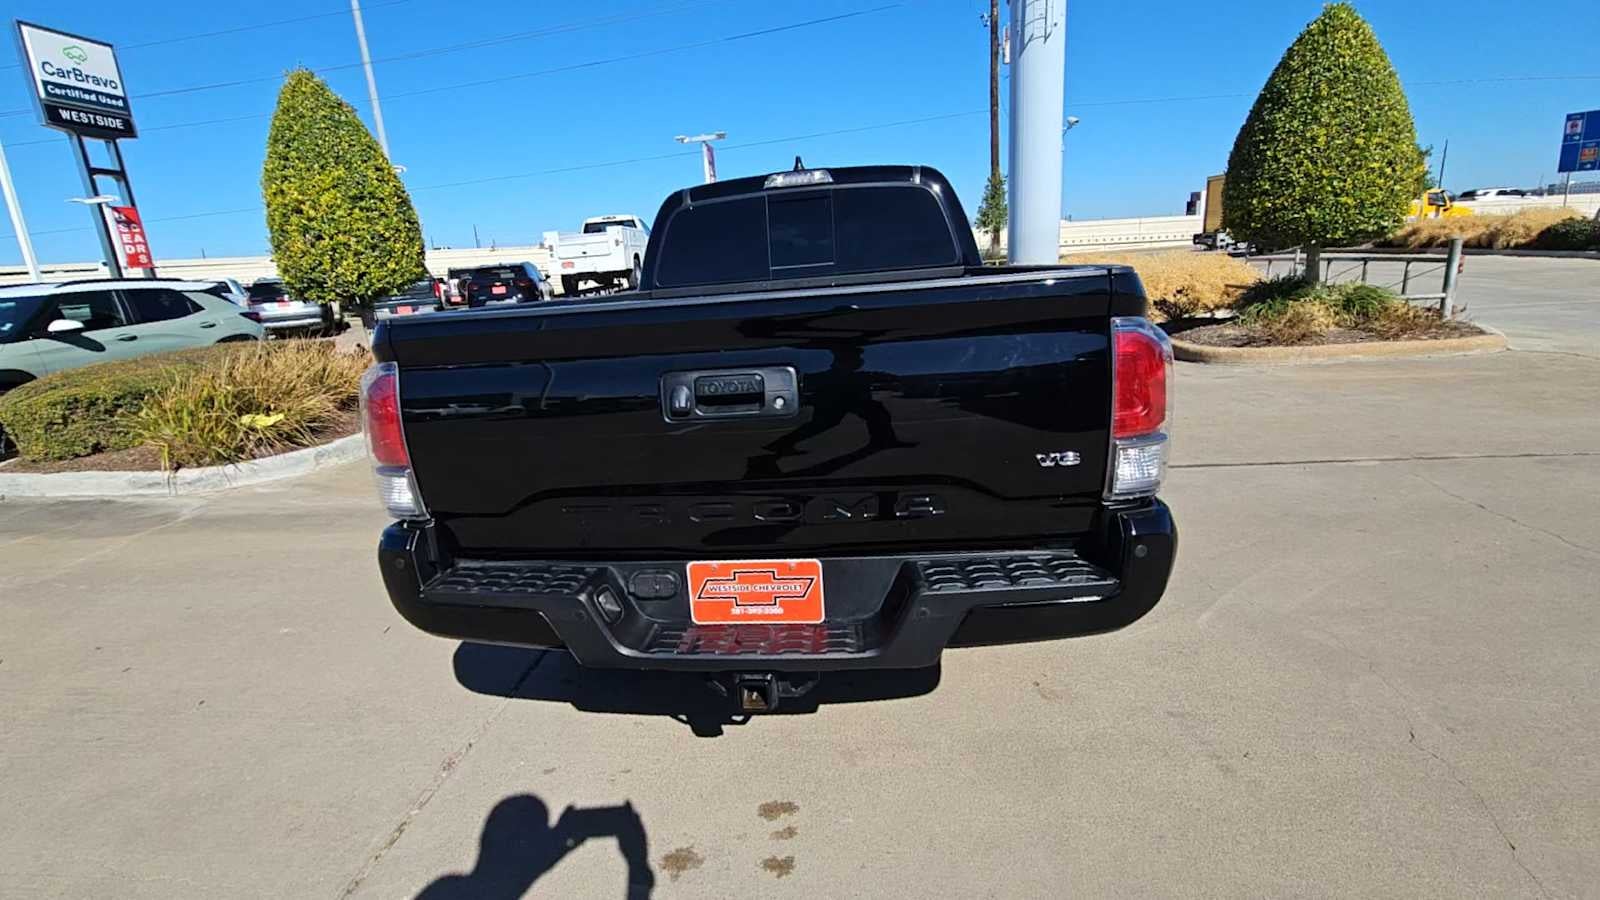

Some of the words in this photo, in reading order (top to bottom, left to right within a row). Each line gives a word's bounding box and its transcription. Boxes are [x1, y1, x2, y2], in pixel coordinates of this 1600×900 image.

[41, 60, 118, 90] CarBravo
[47, 84, 97, 102] Certified
[98, 95, 124, 107] Used
[59, 108, 125, 130] WESTSIDE
[698, 378, 757, 394] TOYOTA
[1035, 451, 1081, 467] V6
[709, 584, 750, 593] WESTSIDE
[753, 583, 802, 592] CHEVROLET
